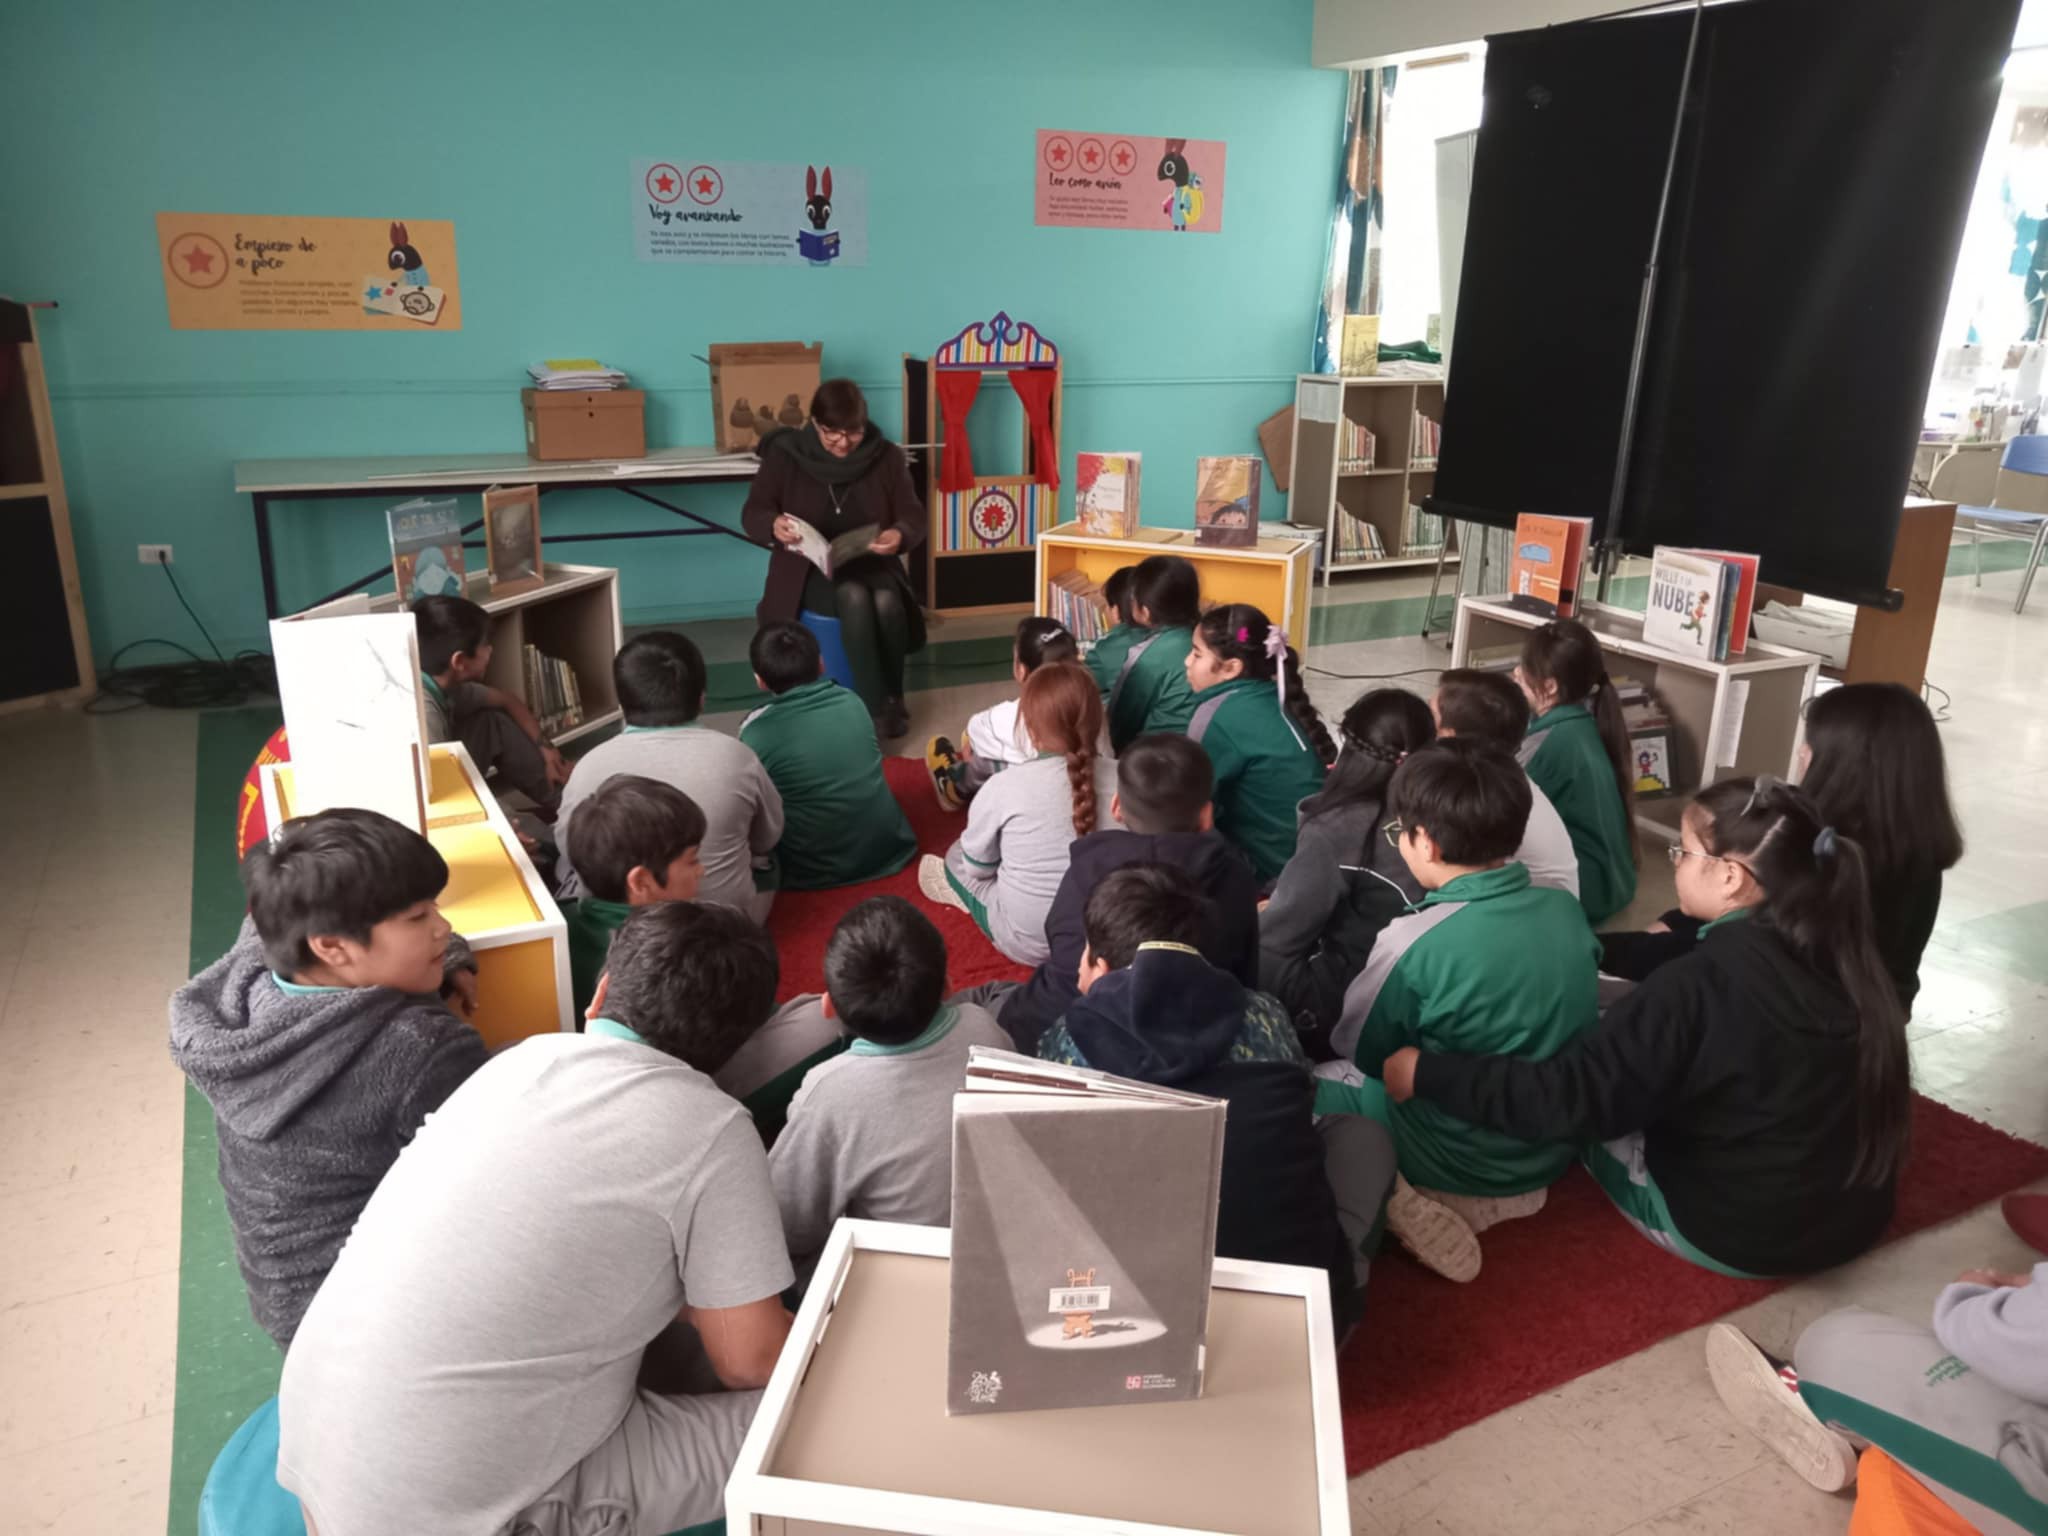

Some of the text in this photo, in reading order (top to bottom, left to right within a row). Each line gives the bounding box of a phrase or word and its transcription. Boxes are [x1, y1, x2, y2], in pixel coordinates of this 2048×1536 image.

[648, 203, 743, 225] Voy avanzando
[298, 237, 317, 251] de
[251, 257, 285, 276] poco
[1652, 581, 1696, 617] NUBE
